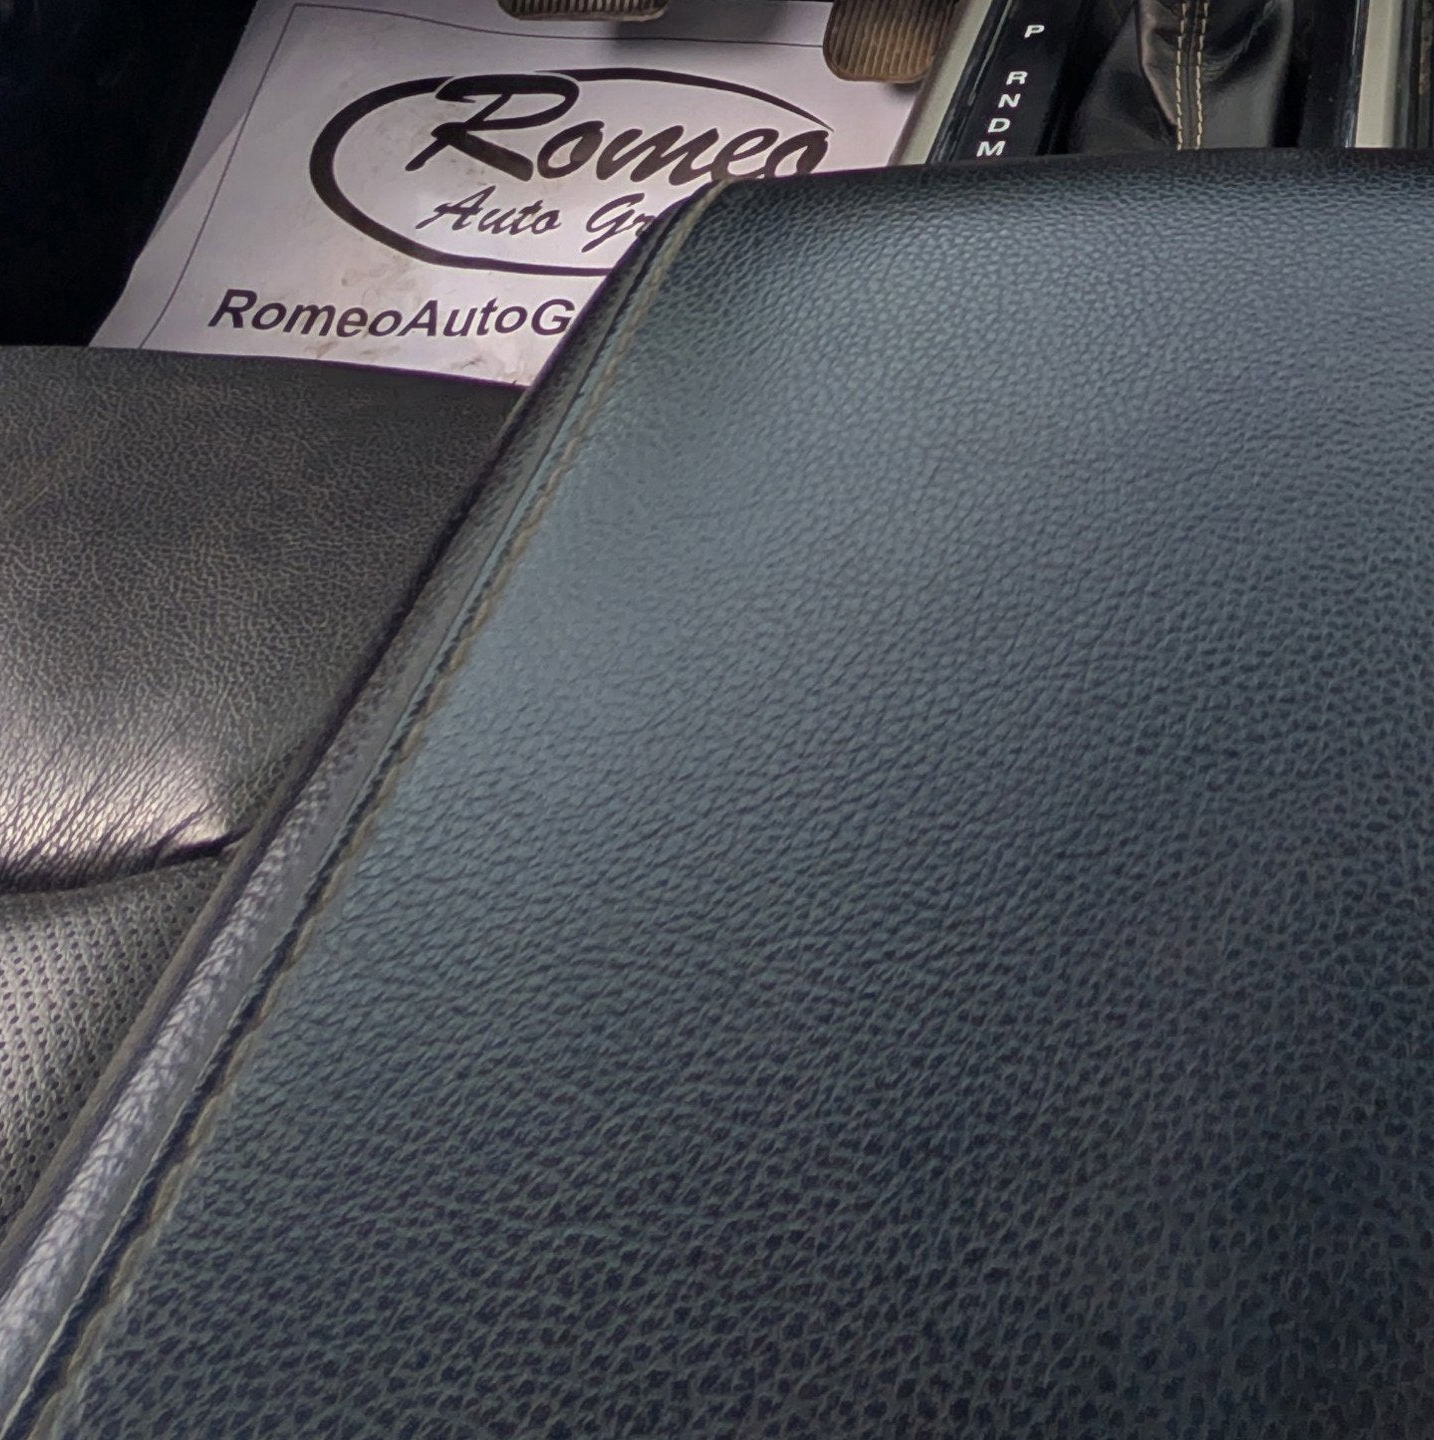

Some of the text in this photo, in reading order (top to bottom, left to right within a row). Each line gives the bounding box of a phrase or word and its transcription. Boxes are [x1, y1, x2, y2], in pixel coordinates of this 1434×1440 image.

[1024, 24, 1045, 38] P
[1006, 71, 1028, 85] R
[998, 93, 1021, 108] N
[405, 74, 828, 185] Romeo
[987, 118, 1011, 133] D
[976, 140, 1006, 157] M
[416, 185, 562, 236] Auto
